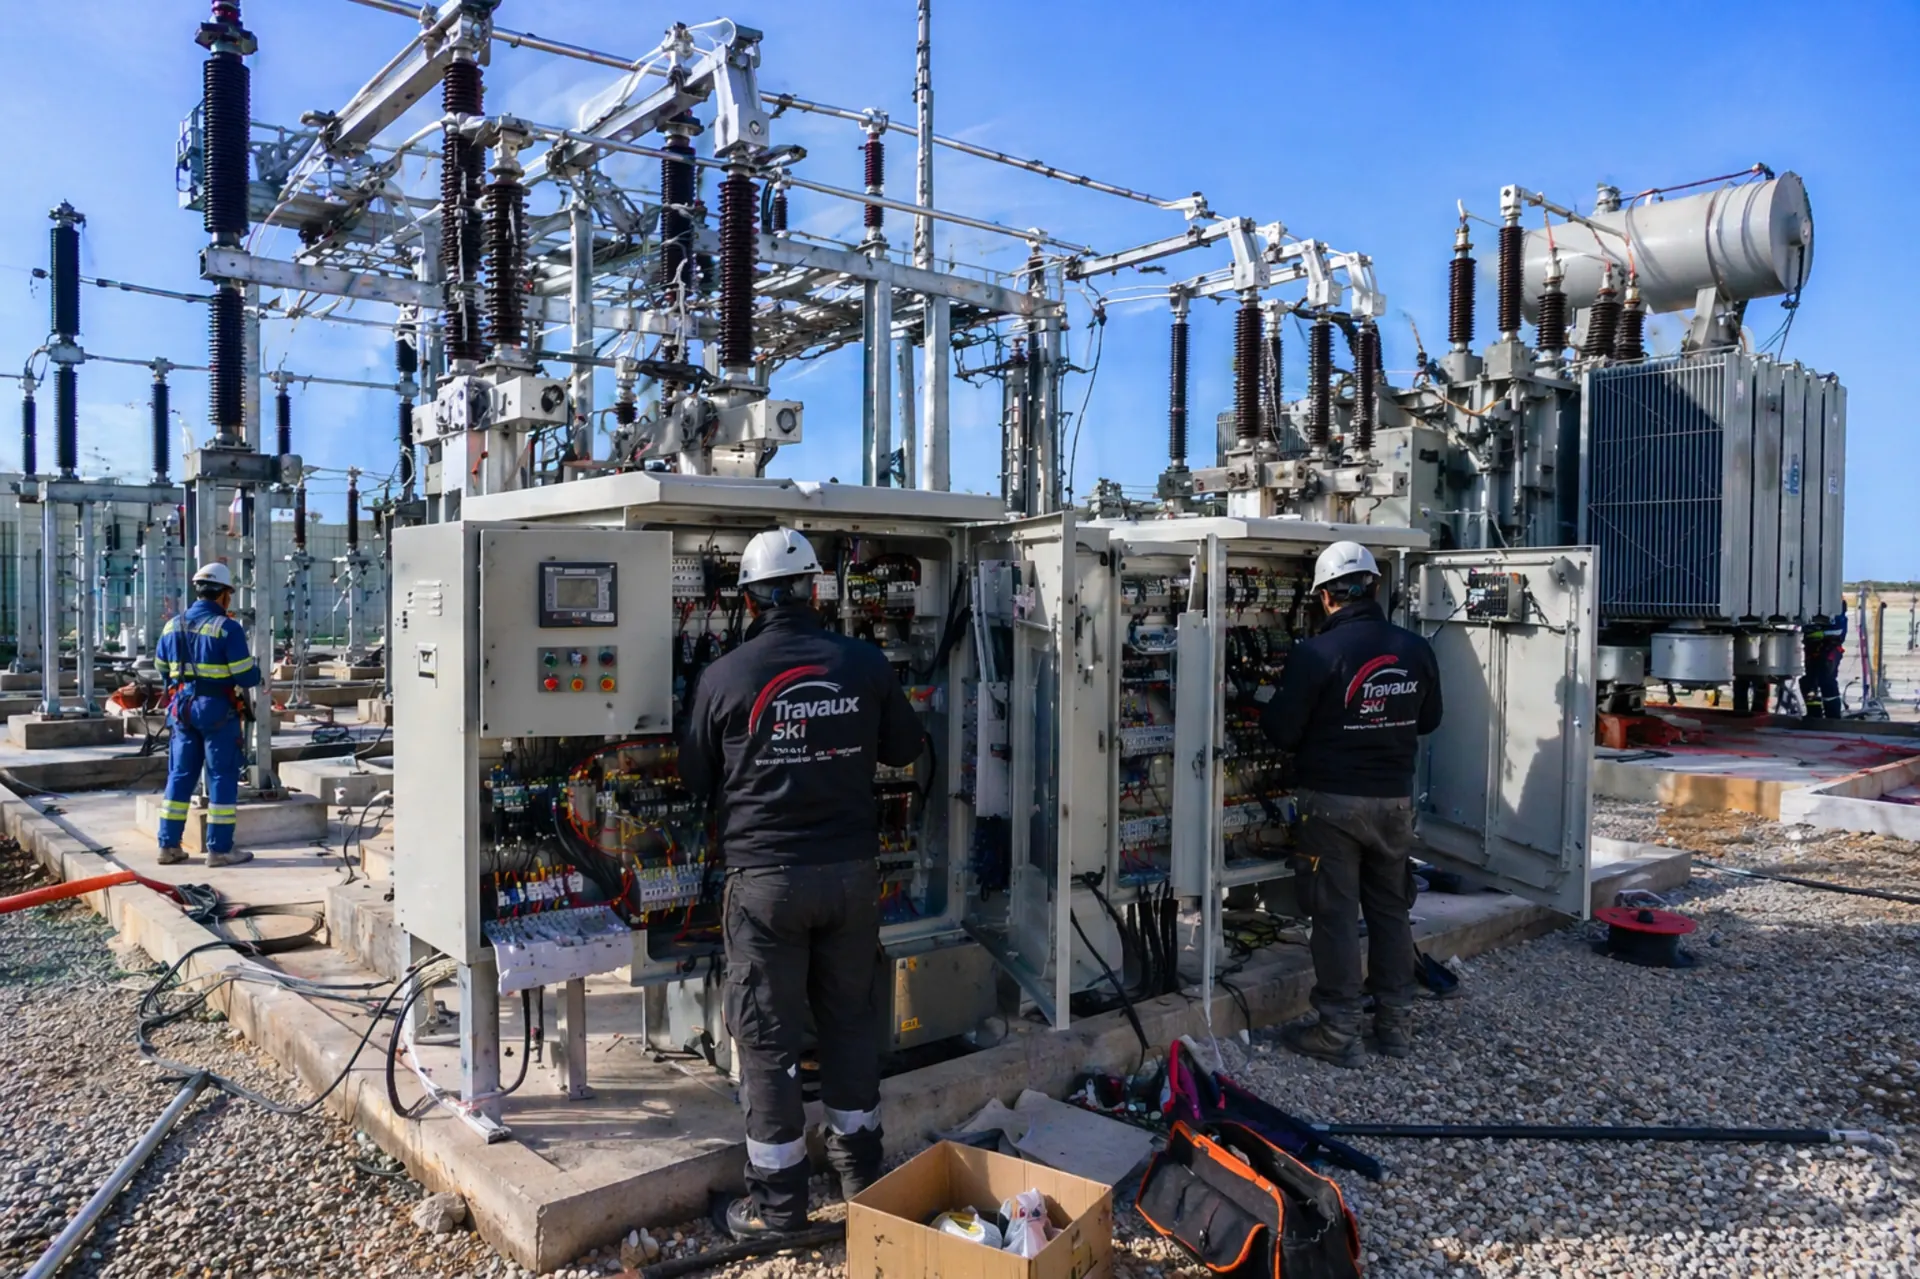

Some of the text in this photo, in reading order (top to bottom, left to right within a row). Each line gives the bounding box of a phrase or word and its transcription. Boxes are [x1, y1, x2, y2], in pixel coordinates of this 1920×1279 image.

[1362, 681, 1419, 698] Travaux
[772, 696, 860, 722] Travaux
[771, 719, 808, 741] Ski
